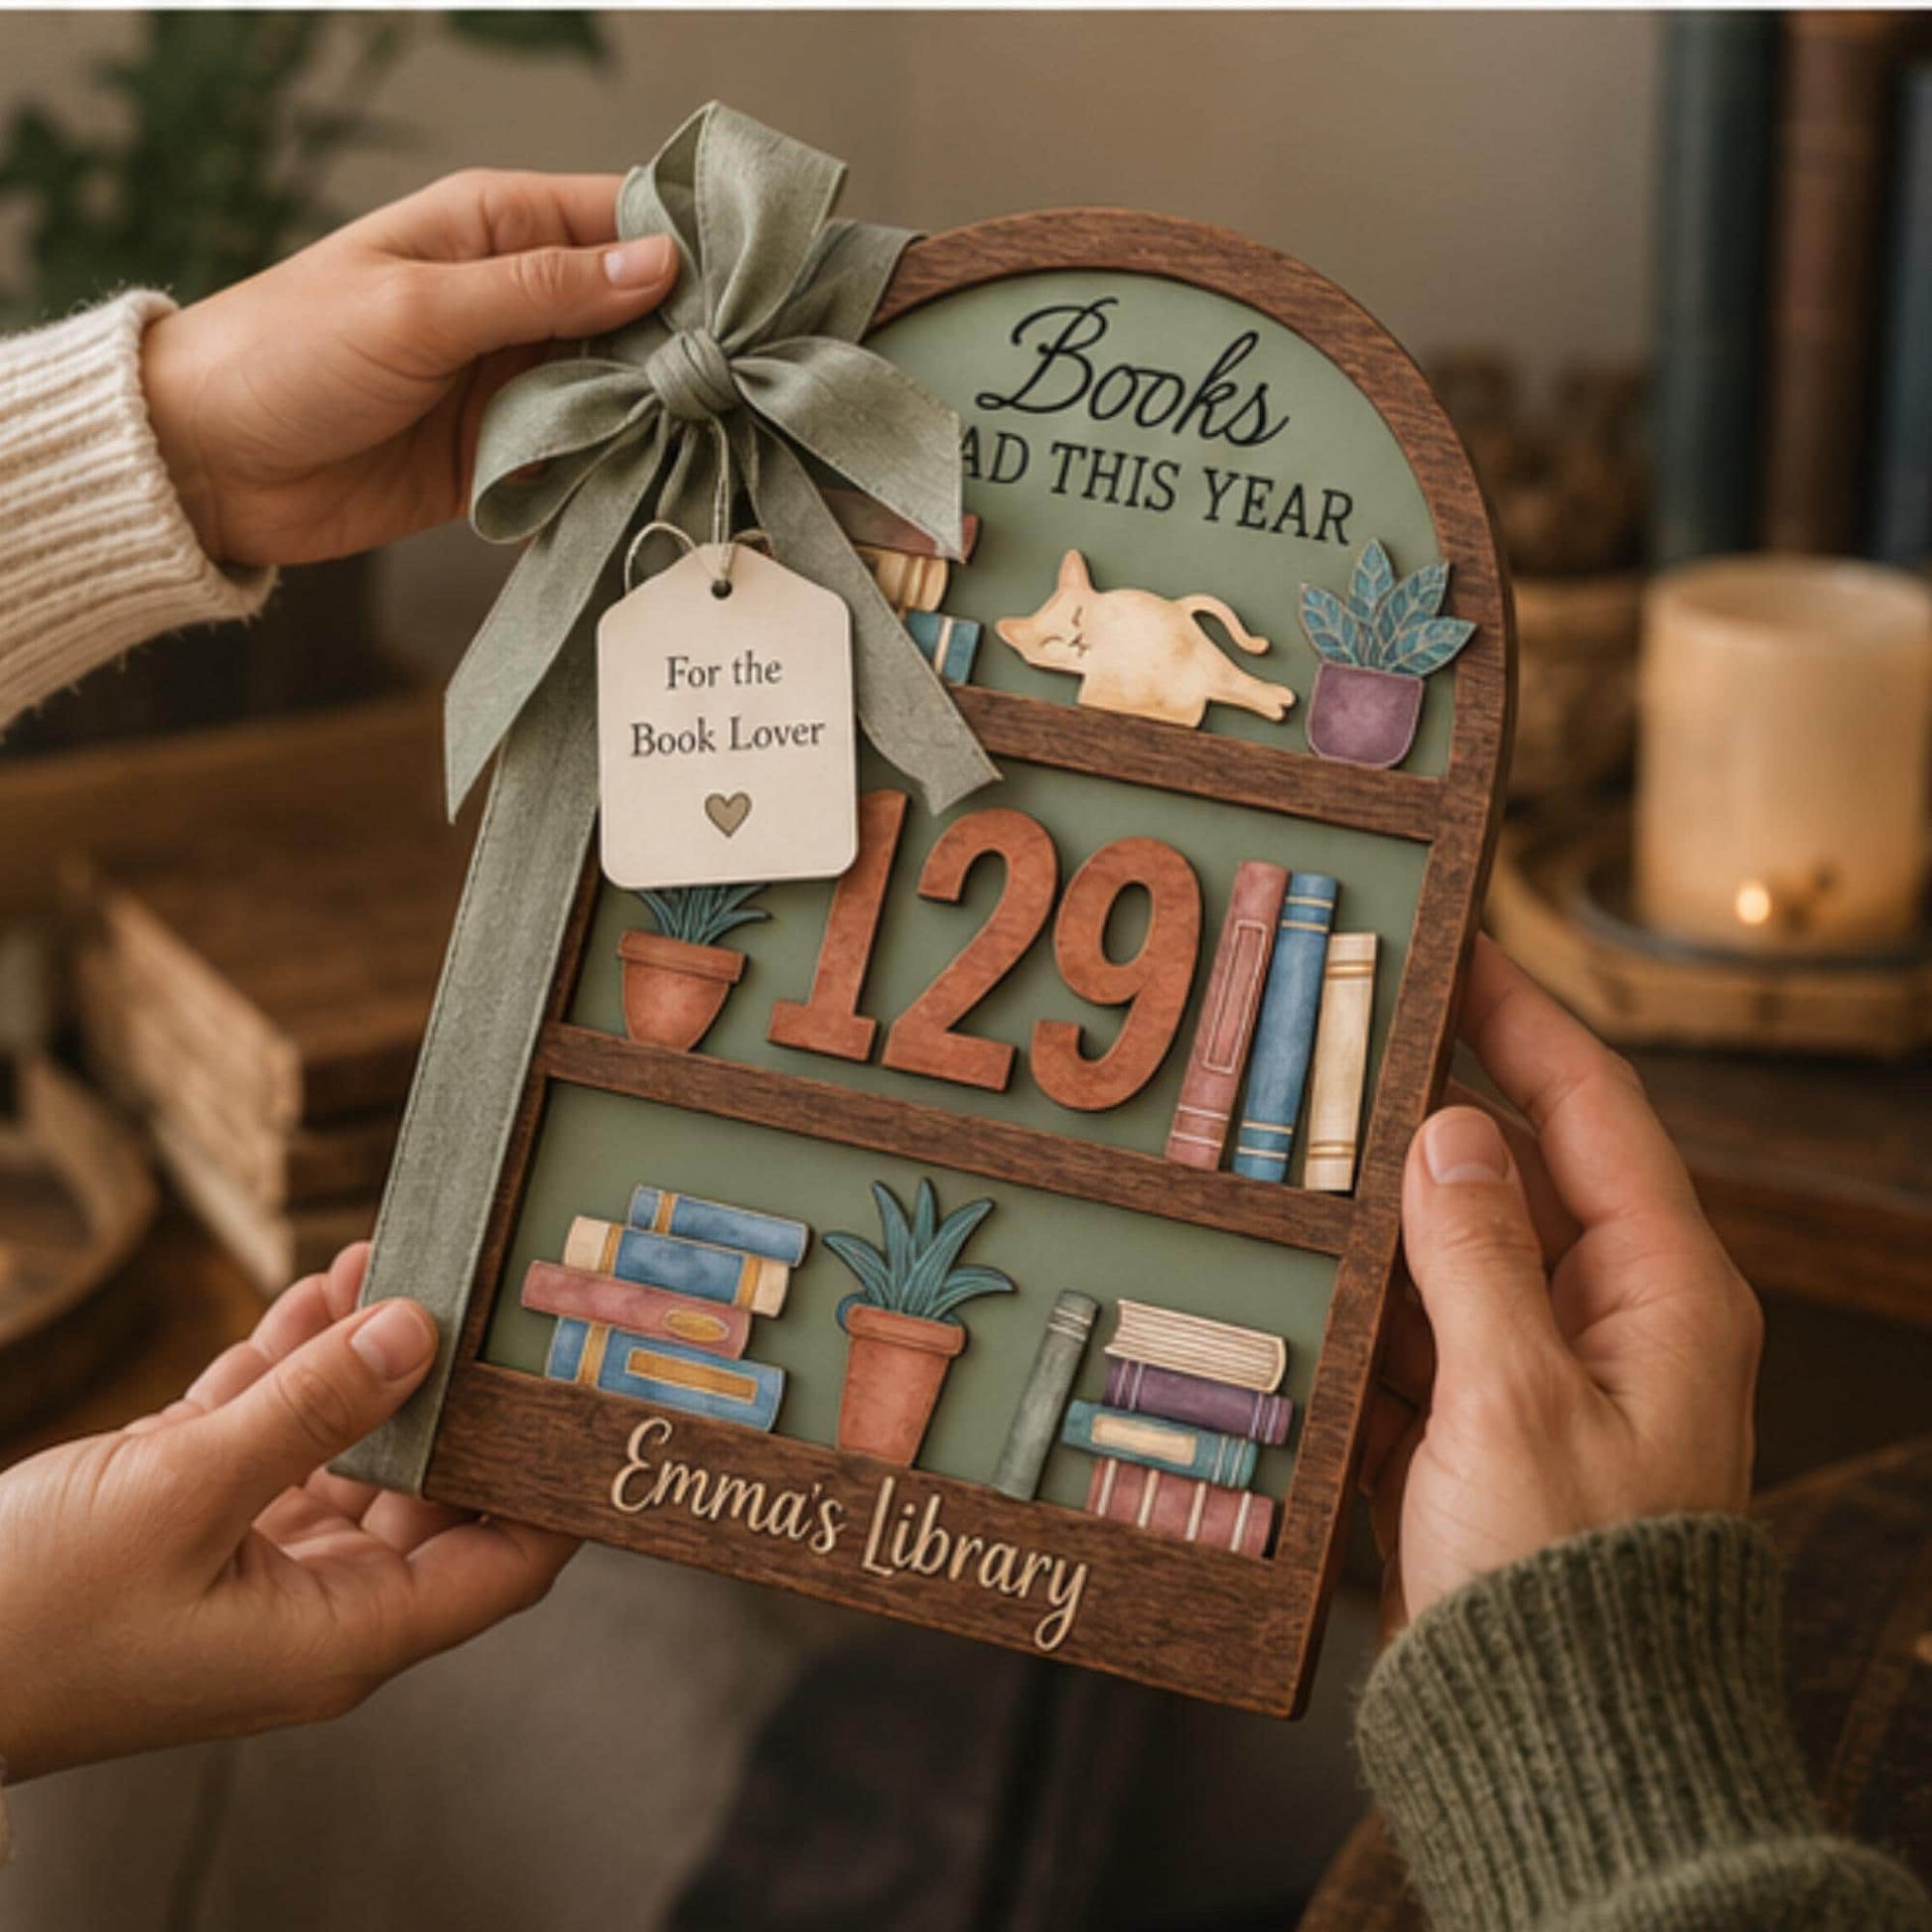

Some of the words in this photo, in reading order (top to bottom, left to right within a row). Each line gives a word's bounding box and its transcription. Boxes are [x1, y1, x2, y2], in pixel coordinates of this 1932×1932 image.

[975, 297, 1289, 447] Books
[960, 425, 1030, 484] AD
[1049, 440, 1180, 513] THIS
[1202, 467, 1354, 546] YEAR
[629, 716, 717, 758] Book
[728, 716, 826, 752] Lover
[665, 655, 722, 690] For
[732, 649, 782, 686] the
[766, 788, 1204, 1113] 129
[610, 1416, 849, 1556] Emma's
[861, 1475, 1088, 1652] Library
